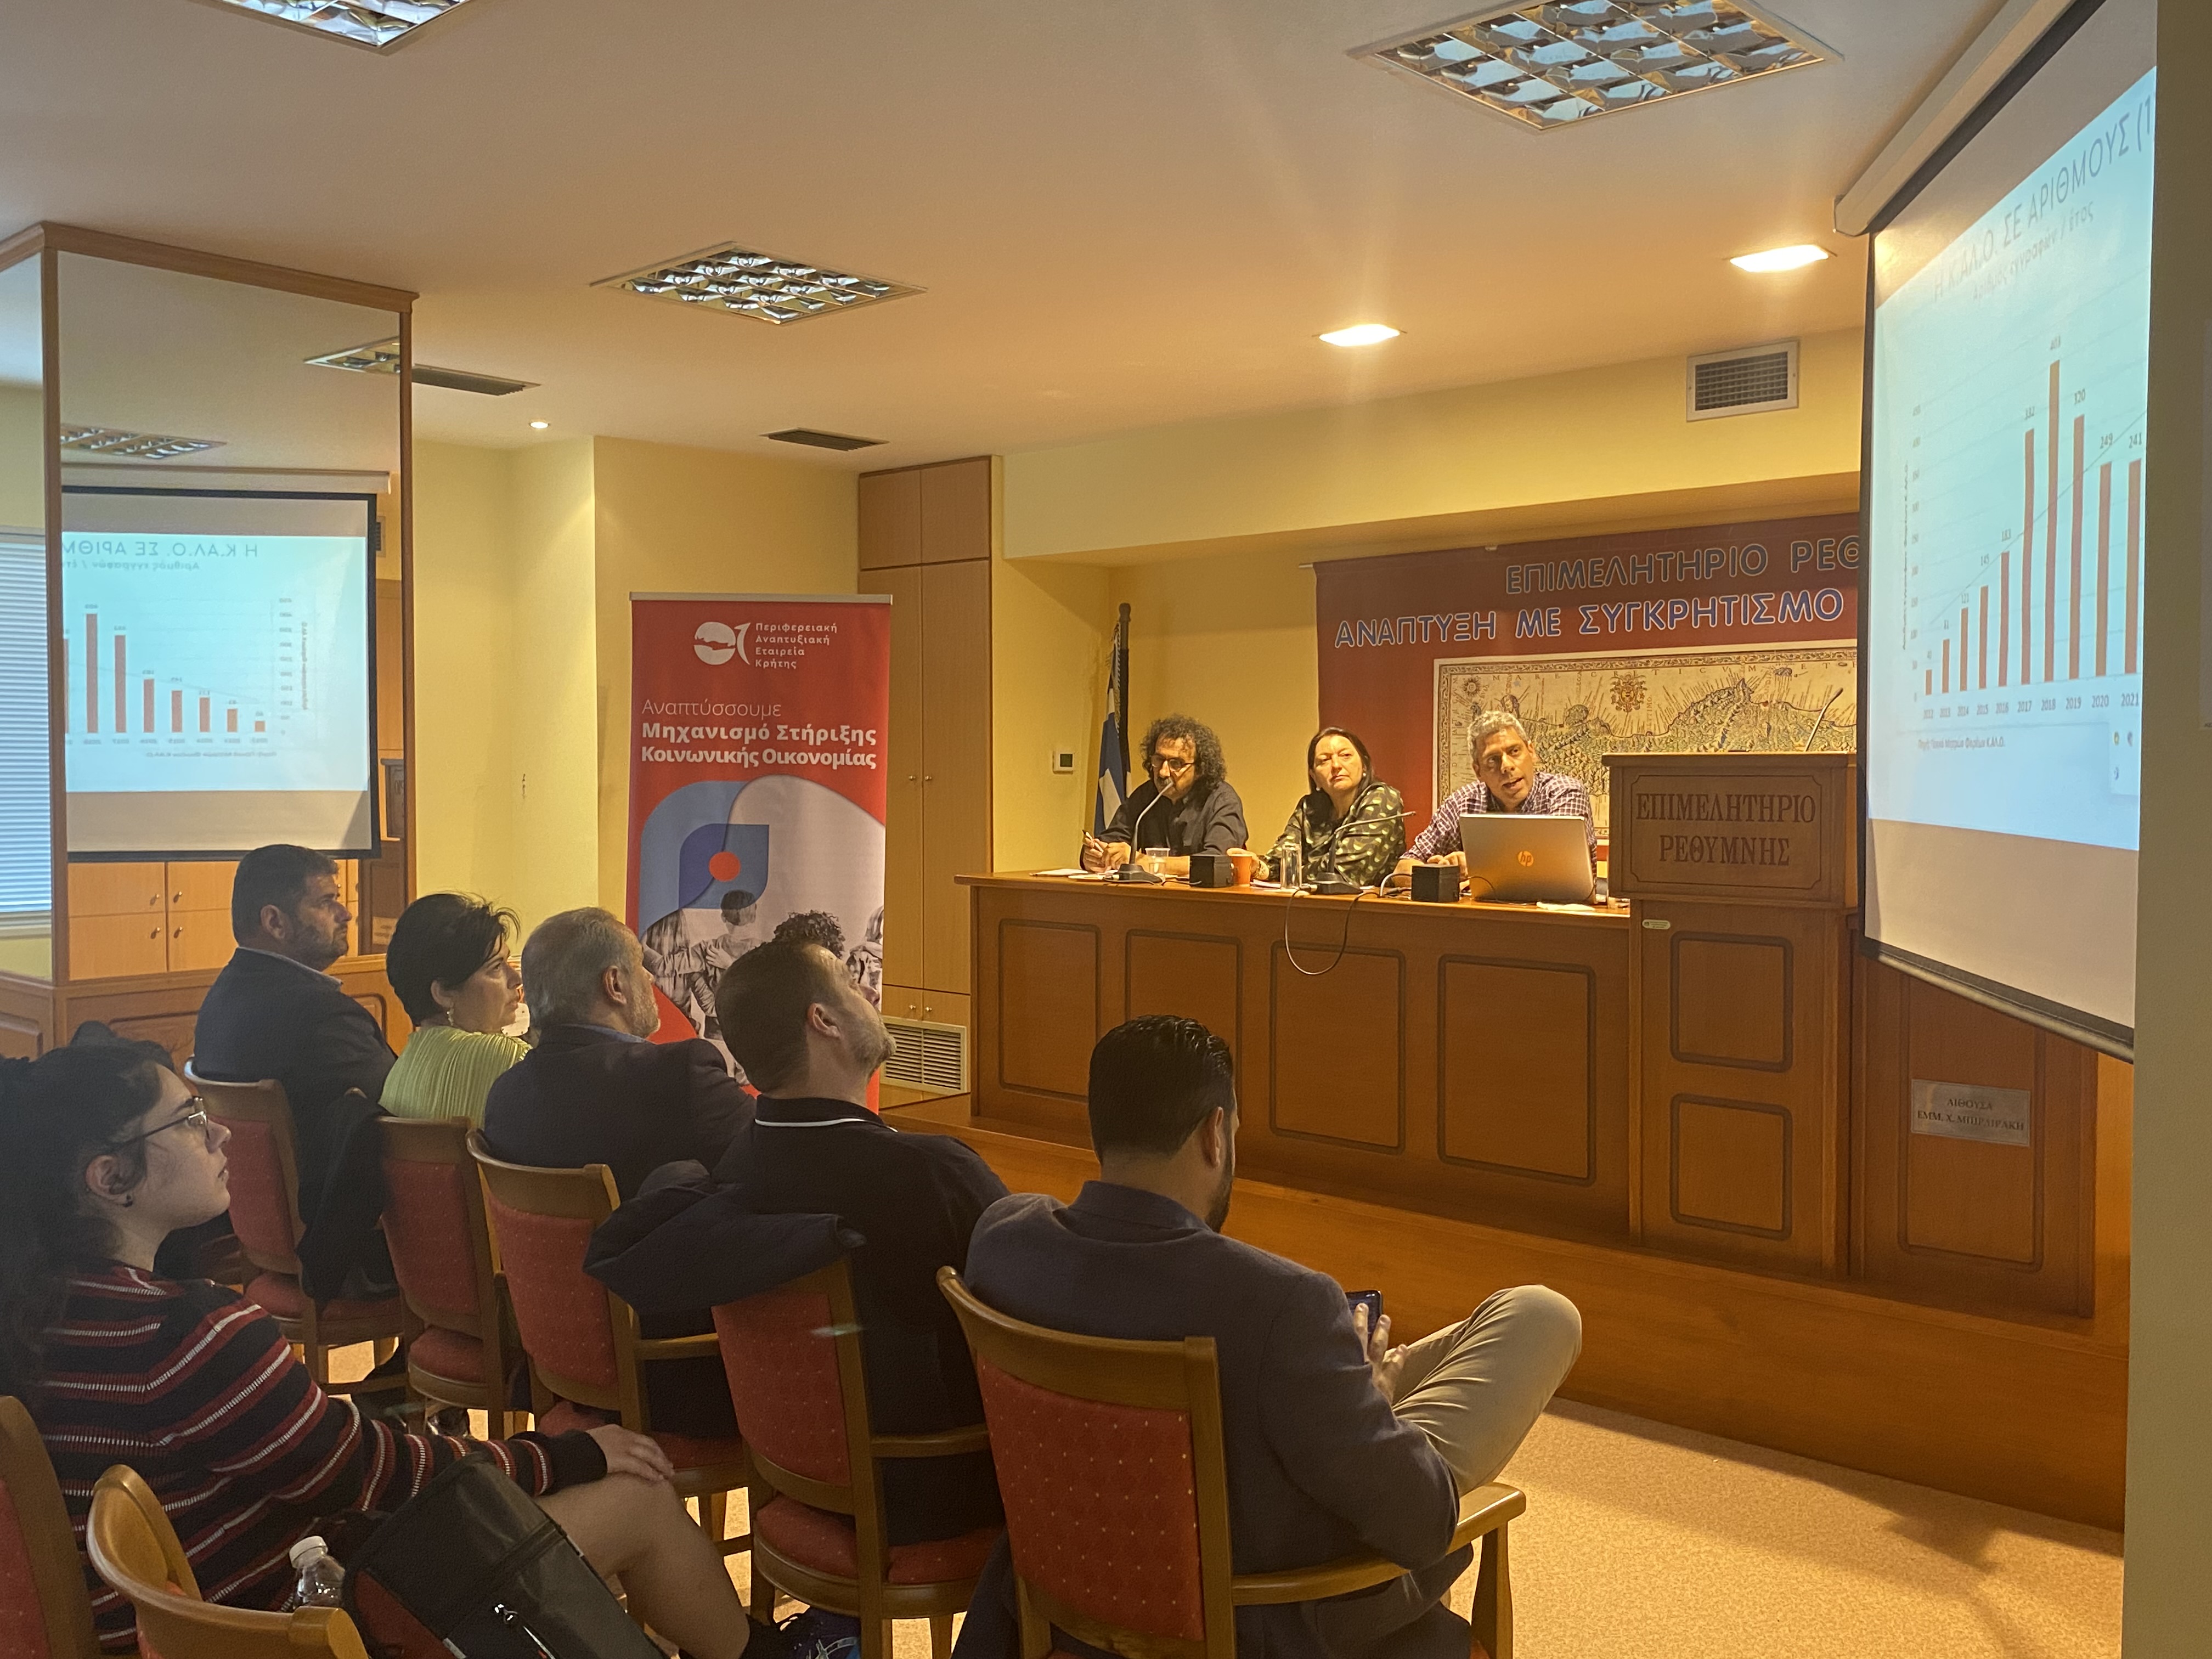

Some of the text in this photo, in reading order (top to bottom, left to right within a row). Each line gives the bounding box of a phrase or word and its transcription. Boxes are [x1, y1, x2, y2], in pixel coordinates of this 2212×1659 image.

[2004, 203, 2023, 247] ΣΕ
[2028, 111, 2130, 229] ΑΡΙΘΜΟΥΣ
[2100, 432, 2114, 450] 249
[2128, 432, 2142, 449] 241
[1506, 535, 1859, 595] ΕΠΙΜΕΛΗΤΗΡΙΟ ΡΕΘ
[755, 623, 838, 633] Περιφερειακή
[1335, 588, 1844, 648] ΑΝΑΠΤΥΞΗ ΜΕ ΣΥΓΚΡΗΤΙΣΜΟ
[755, 635, 831, 646] Αναπτυξιακή
[755, 646, 805, 657] Εταιρεία
[755, 658, 797, 669] Κρήτης
[641, 698, 782, 721] Αναπτύσσουμε
[1976, 703, 1989, 716] 2015
[1995, 702, 2010, 714] 2016
[2017, 699, 2032, 713] 2017
[2040, 698, 2056, 712] 2018
[2066, 696, 2082, 710] 2019
[2091, 693, 2109, 708] 2020
[2121, 691, 2140, 707] 2021
[642, 723, 877, 747] Μηχανισμό Στήριξης
[641, 746, 877, 770] Κοινωνικής Οικονομίας
[1635, 793, 1816, 823] ΕΠΙΜΕΛΗΤΗΡΙΟ
[1520, 851, 1532, 867] hp
[1659, 834, 1790, 866] ΡΕΘΥΜΝΗΣ
[1947, 1098, 1993, 1110] ΑΙΘΟΥΣΑ
[1917, 1110, 1943, 1122] ΕΜΜ.
